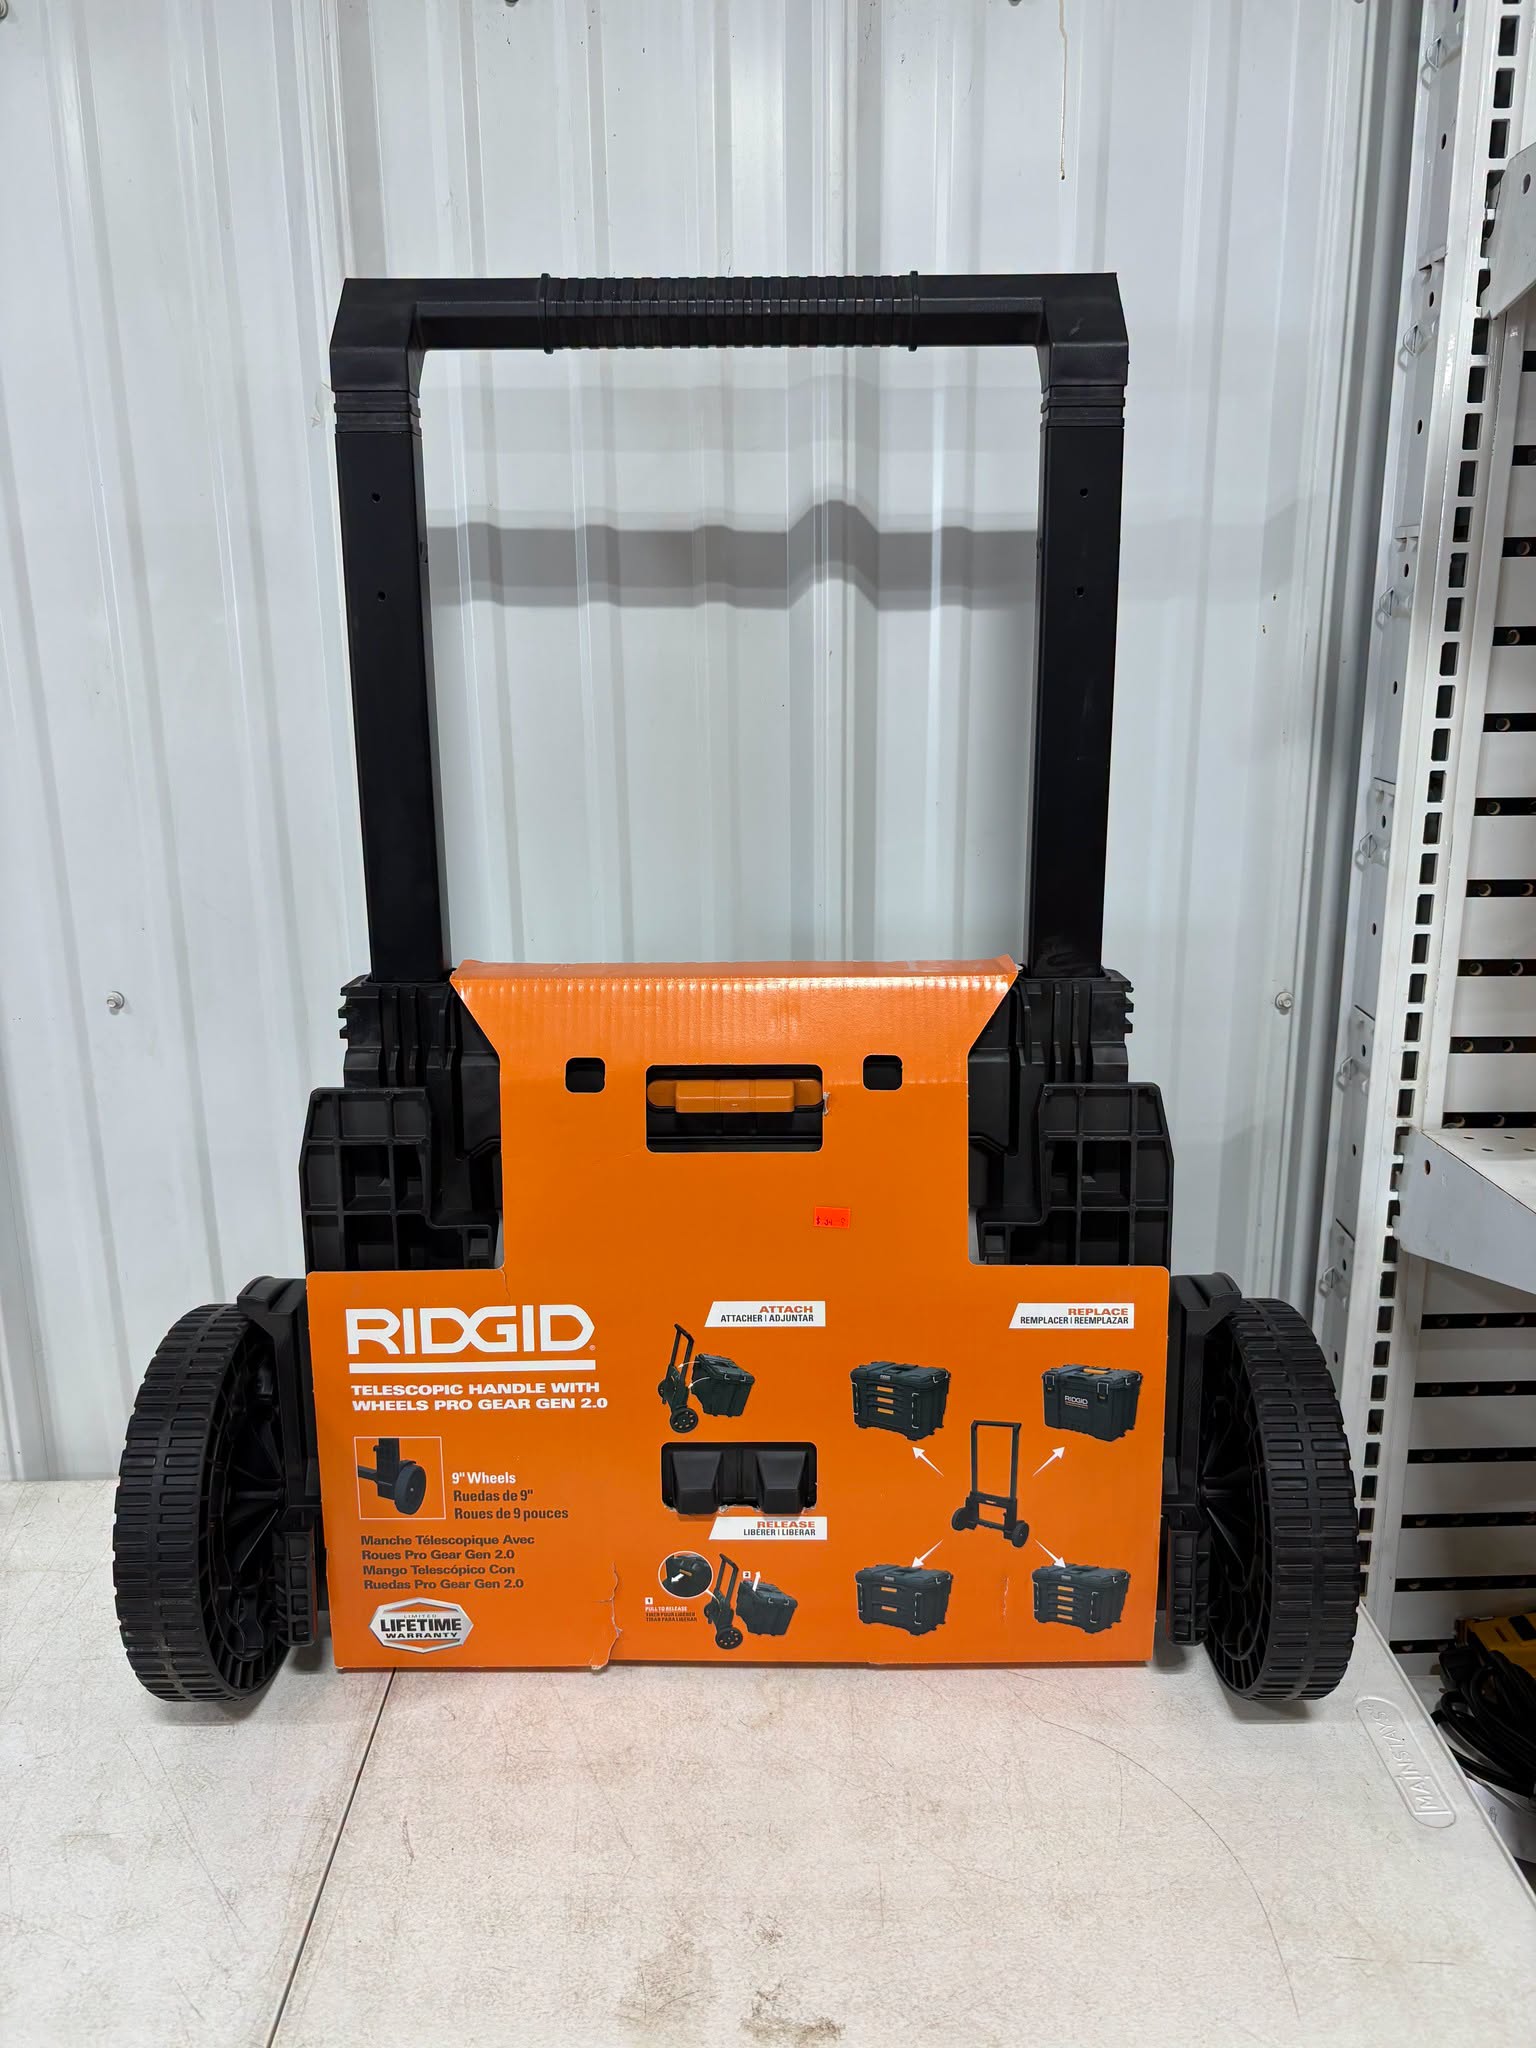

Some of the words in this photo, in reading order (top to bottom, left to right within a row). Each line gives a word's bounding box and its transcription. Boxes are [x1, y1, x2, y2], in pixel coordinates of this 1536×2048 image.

[759, 1305, 813, 1313] ATTACH
[1067, 1308, 1129, 1316] REPLACE
[720, 1314, 763, 1323] ATTACHER
[769, 1314, 814, 1322] ADJUNTAR
[1020, 1316, 1069, 1325] REMPLACER
[1074, 1316, 1129, 1325] REEMPLAZAR
[345, 1304, 595, 1355] RIDGID
[350, 1384, 463, 1396] TELESCOPIC
[468, 1383, 546, 1395] HANDLE
[550, 1382, 600, 1394] WITH
[352, 1400, 429, 1411] WHEELS
[434, 1399, 473, 1411] PRO
[477, 1399, 531, 1410] GEAR
[535, 1398, 576, 1409] GEN
[580, 1397, 608, 1409] 2.0
[451, 1472, 465, 1484] 9"
[466, 1471, 516, 1484] Wheels
[453, 1489, 500, 1502] Ruedas
[502, 1489, 518, 1501] de
[520, 1489, 534, 1501] 9"
[454, 1507, 493, 1520] Roues
[495, 1507, 511, 1519] de
[513, 1507, 521, 1519] 9
[523, 1509, 569, 1522] pouces
[757, 1520, 816, 1528] RELEASE
[781, 1528, 816, 1536] LIBERAR
[360, 1535, 412, 1545] Manche
[415, 1534, 500, 1547] Télescopique
[502, 1535, 536, 1545] Avec
[361, 1550, 401, 1560] Roues
[404, 1550, 428, 1560] Pro
[430, 1550, 462, 1560] Gear
[464, 1549, 491, 1559] Gen
[494, 1549, 515, 1559] 2.0
[362, 1565, 408, 1577] Mango
[410, 1564, 486, 1577] Telescópico
[488, 1564, 516, 1574] Con
[363, 1579, 411, 1590] Ruedas
[414, 1579, 437, 1589] Pro
[439, 1579, 471, 1589] Gear
[473, 1578, 500, 1589] Gen
[503, 1578, 525, 1588] 2.0
[380, 1617, 462, 1632] LIFETIME
[1371, 1710, 1441, 1812] MAINSTAYS
